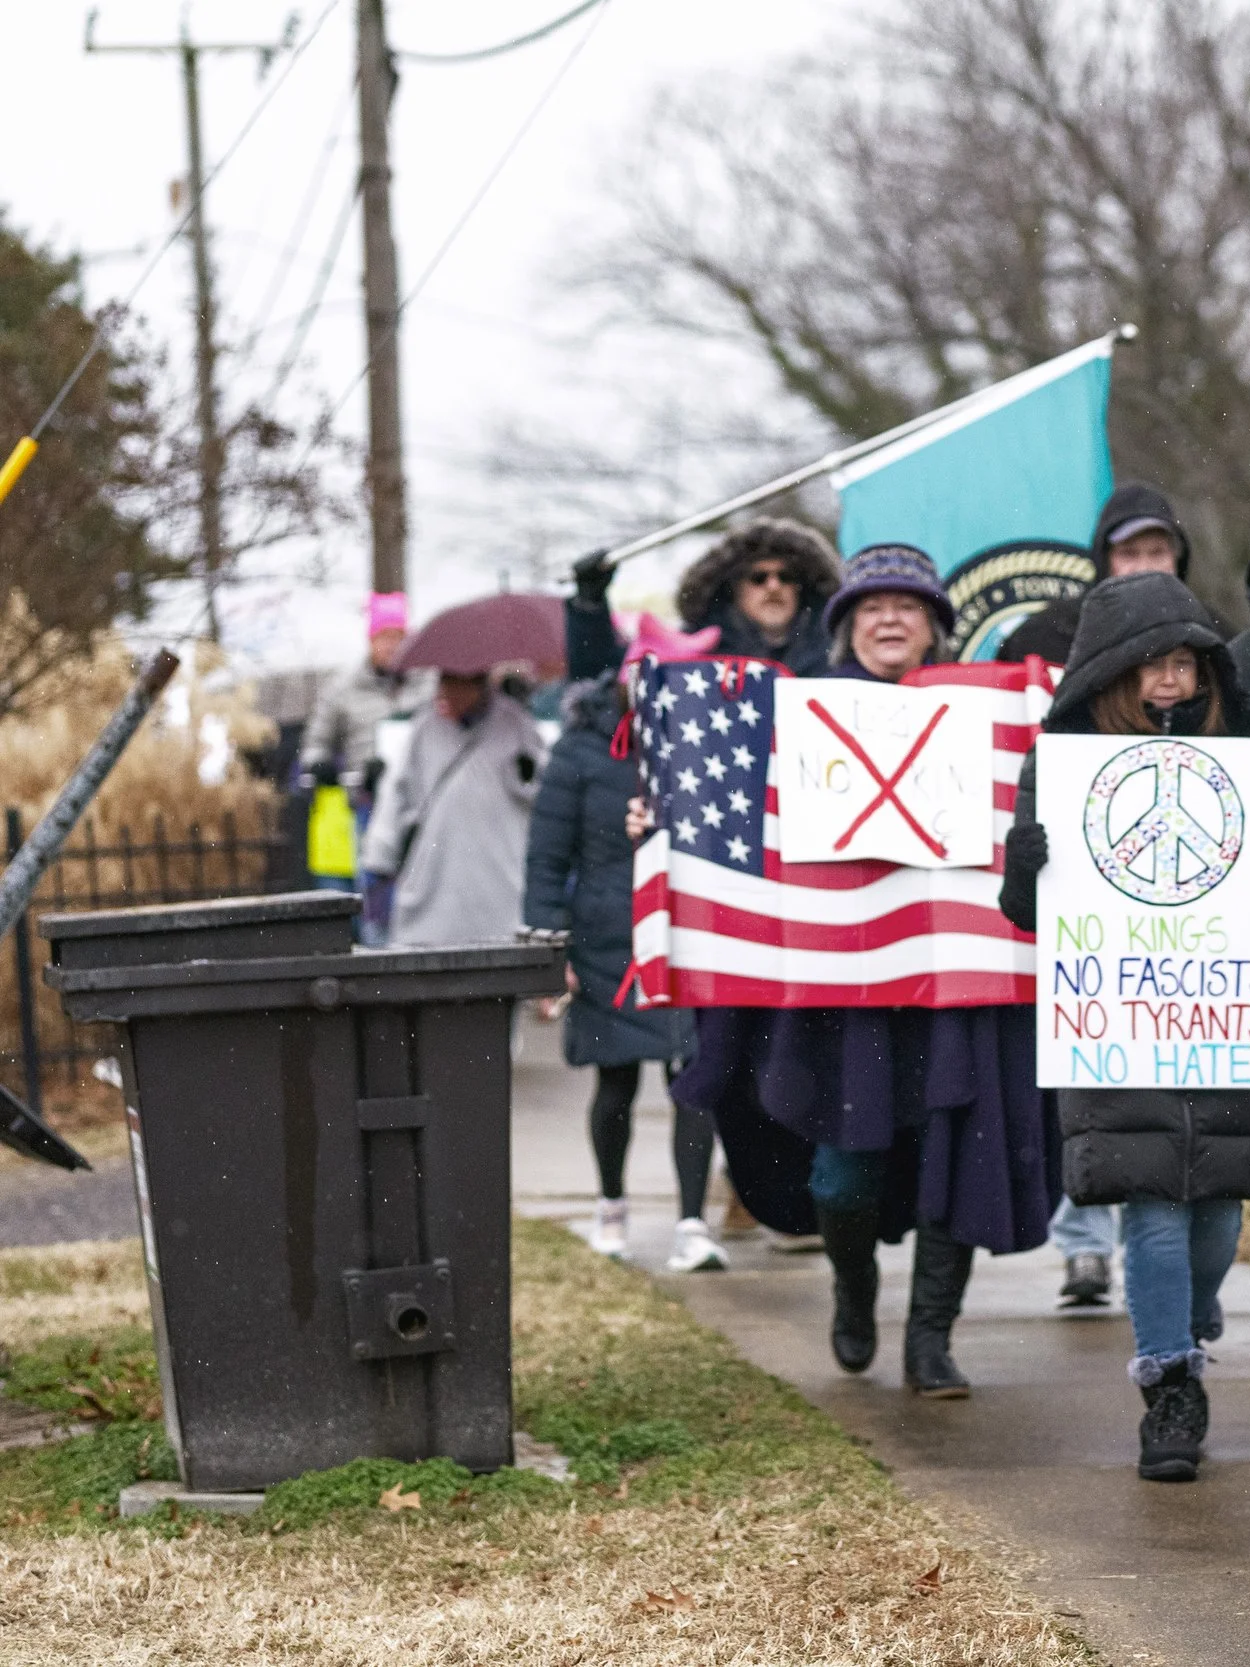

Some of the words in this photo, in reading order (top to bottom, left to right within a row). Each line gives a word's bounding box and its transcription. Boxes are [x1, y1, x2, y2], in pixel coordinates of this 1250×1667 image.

[1056, 914, 1104, 952] NO
[1126, 915, 1229, 953] KINGS
[1054, 956, 1102, 996] NO
[1053, 1000, 1108, 1040] NO
[1070, 1043, 1128, 1084] NO
